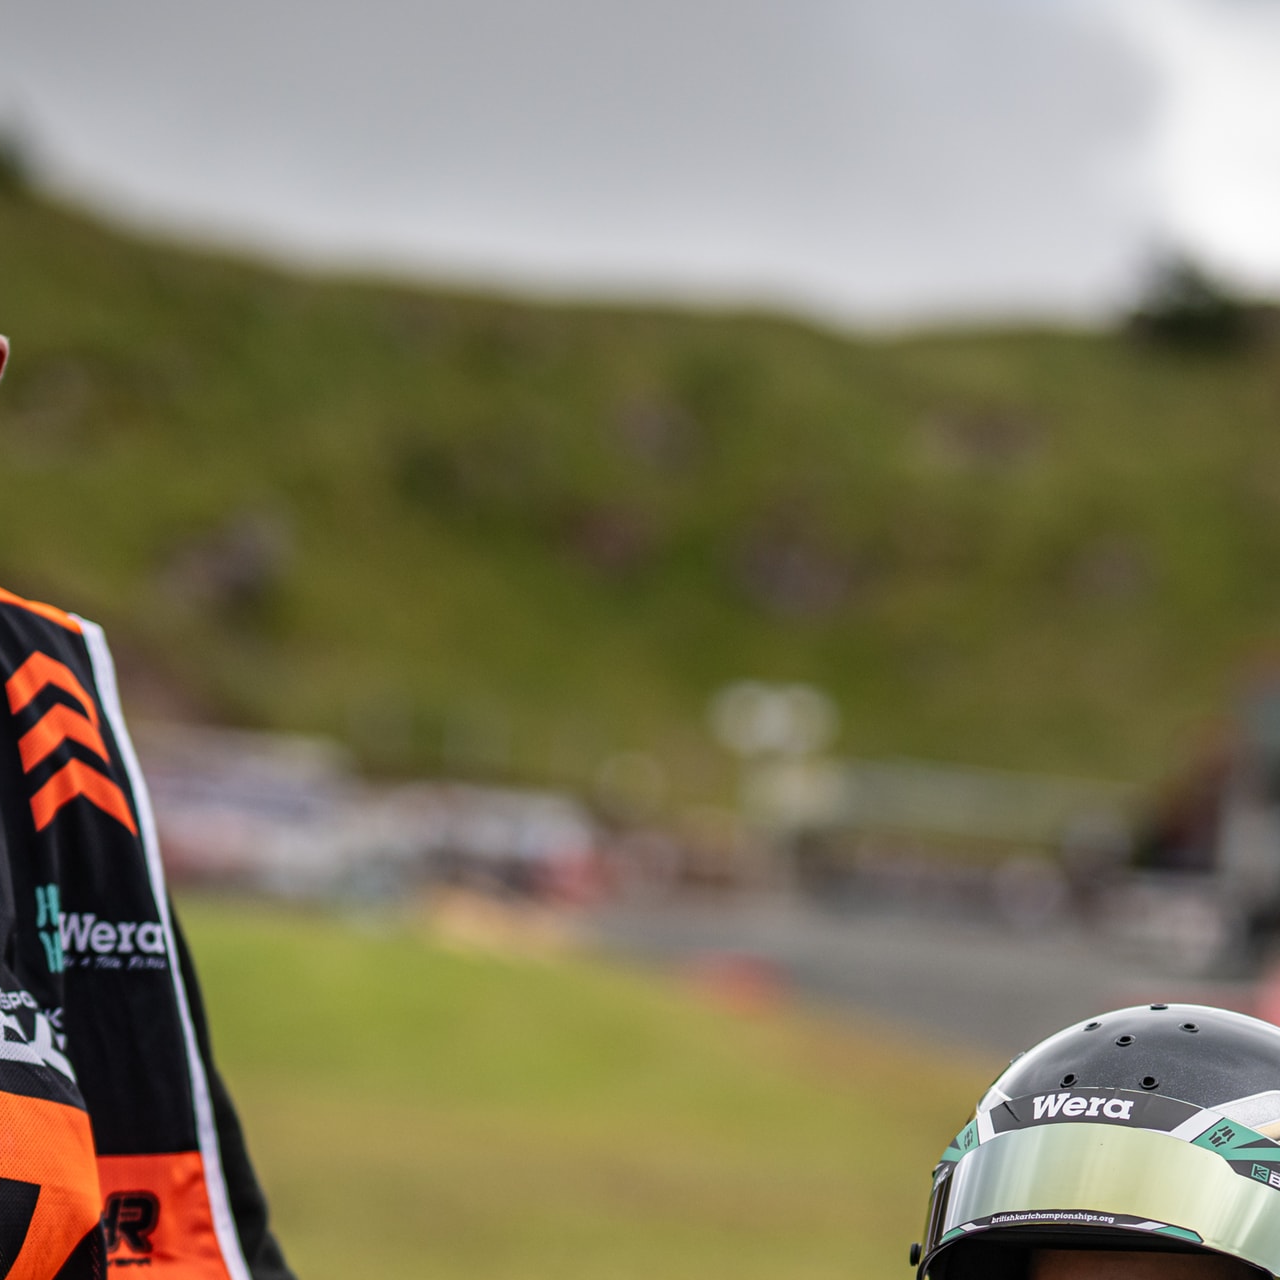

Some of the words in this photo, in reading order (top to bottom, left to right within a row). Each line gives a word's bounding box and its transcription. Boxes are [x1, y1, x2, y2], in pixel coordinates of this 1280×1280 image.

[58, 911, 166, 954] Wera
[1032, 1092, 1135, 1121] Wera
[990, 1212, 1116, 1225] britishkartchampionships.org
